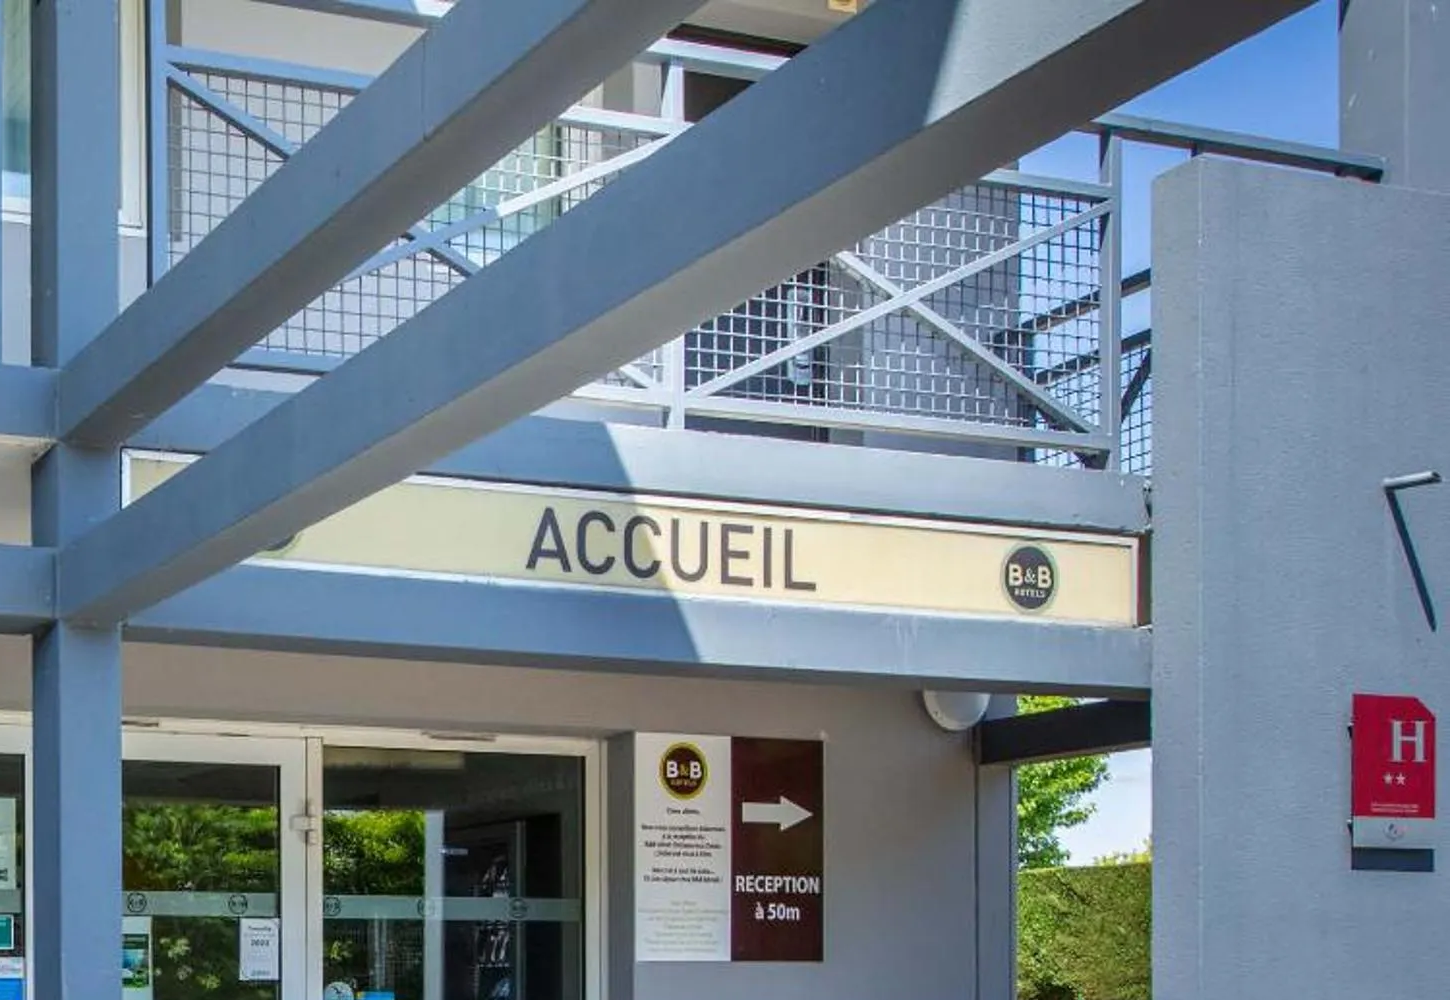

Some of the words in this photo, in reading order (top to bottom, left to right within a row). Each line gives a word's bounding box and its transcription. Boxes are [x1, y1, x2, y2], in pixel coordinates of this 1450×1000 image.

[526, 506, 817, 592] ACCUEIL
[1008, 563, 1052, 589] B&B
[1389, 719, 1428, 763] H
[666, 760, 703, 779] B&B
[735, 875, 820, 894] RECEPTION
[755, 901, 764, 920] à
[767, 903, 800, 920] 50m
